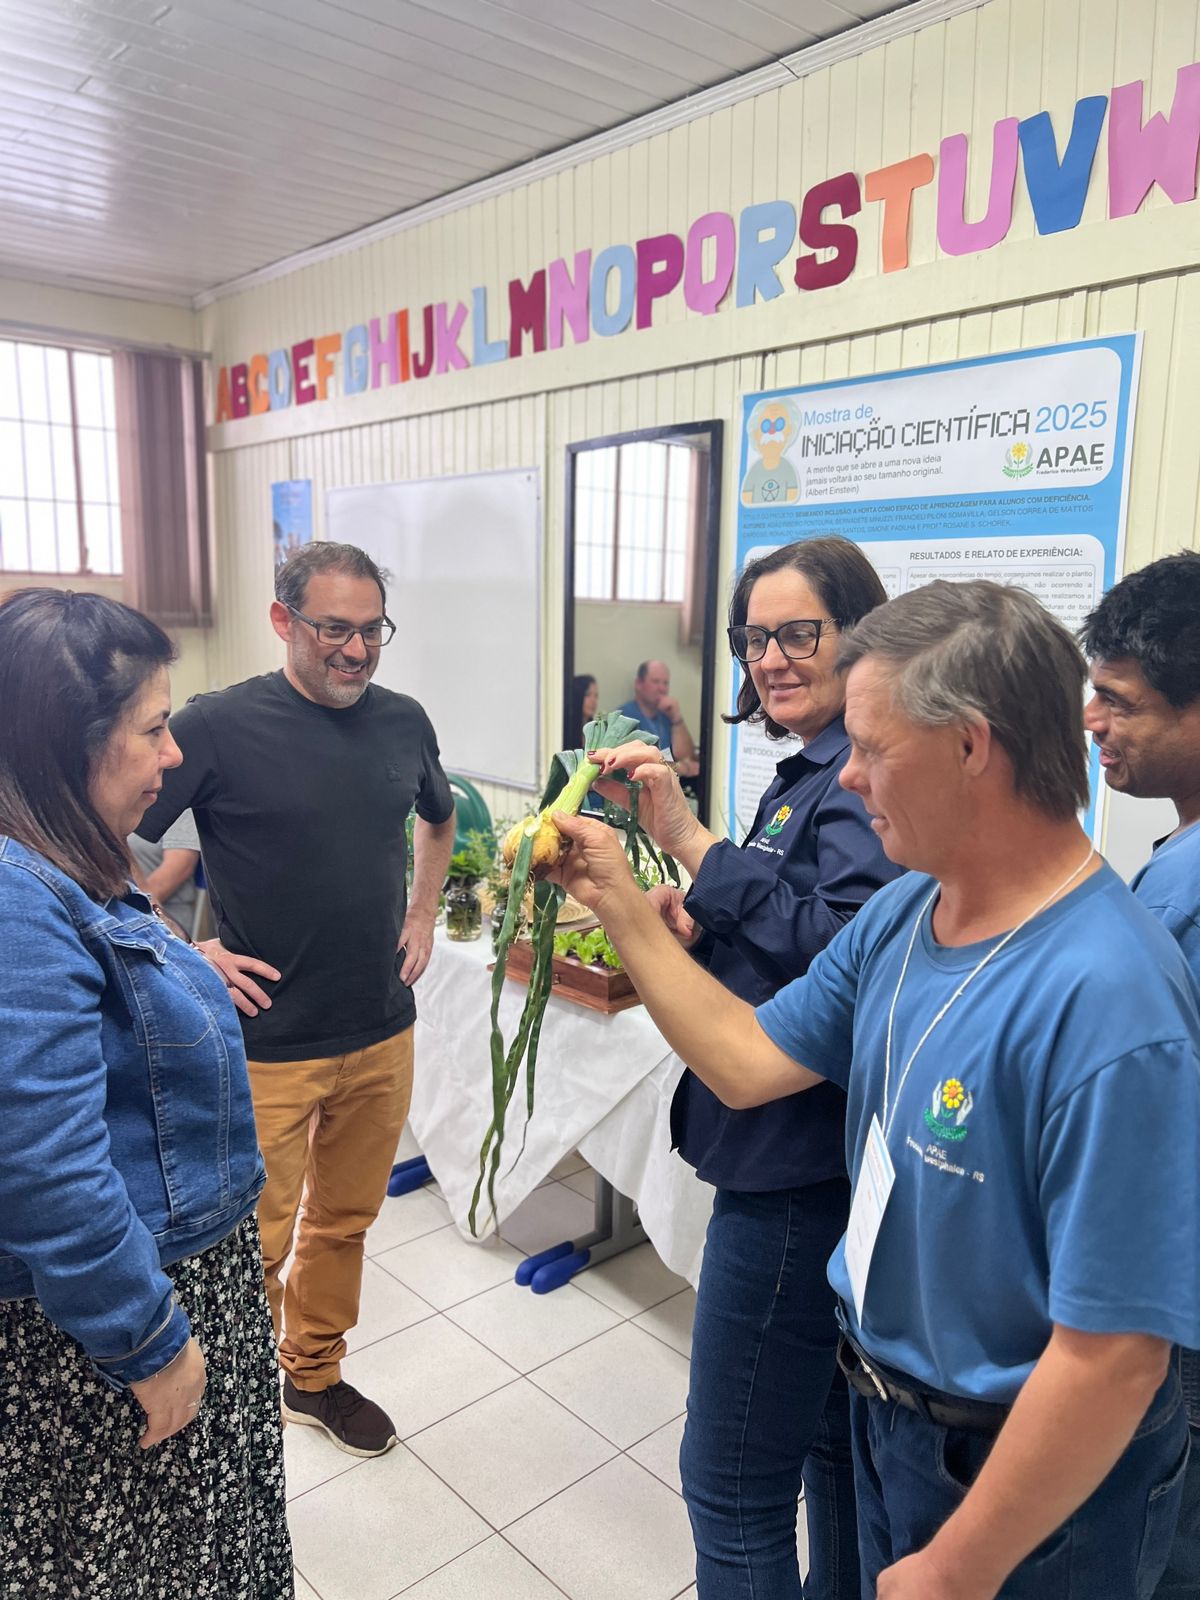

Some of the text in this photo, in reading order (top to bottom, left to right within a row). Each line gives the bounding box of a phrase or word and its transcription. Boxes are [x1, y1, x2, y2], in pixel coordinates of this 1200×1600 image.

[803, 404, 874, 426] Mostra de
[802, 400, 1107, 459] INICIAÇÃO CIENTÍFICA 2025
[807, 466, 812, 474] A
[813, 464, 834, 473] mente
[835, 462, 850, 473] que
[851, 462, 859, 470] se
[860, 458, 877, 469] abre
[884, 457, 901, 467] uma
[902, 455, 922, 465] nova
[922, 453, 942, 463] ideia
[1036, 443, 1105, 469] APAE
[805, 465, 943, 487] jamais voltará ao seu tamanho original.
[805, 483, 861, 497] (Albert Einstein)
[896, 503, 920, 512] ESPAÇO
[930, 500, 978, 509] APRENDIZAGEM
[980, 498, 997, 506] PARA
[999, 497, 1025, 505] ALUNOS
[1027, 495, 1043, 503] COM
[987, 508, 1017, 517] GELSON
[1048, 506, 1059, 514] DE
[1061, 504, 1094, 513] MATTOS
[910, 546, 1083, 560] RESULTADOS E RELATO DE EXPERIÊNCIA:
[1071, 570, 1093, 578] plantio
[972, 1170, 985, 1183] RS
